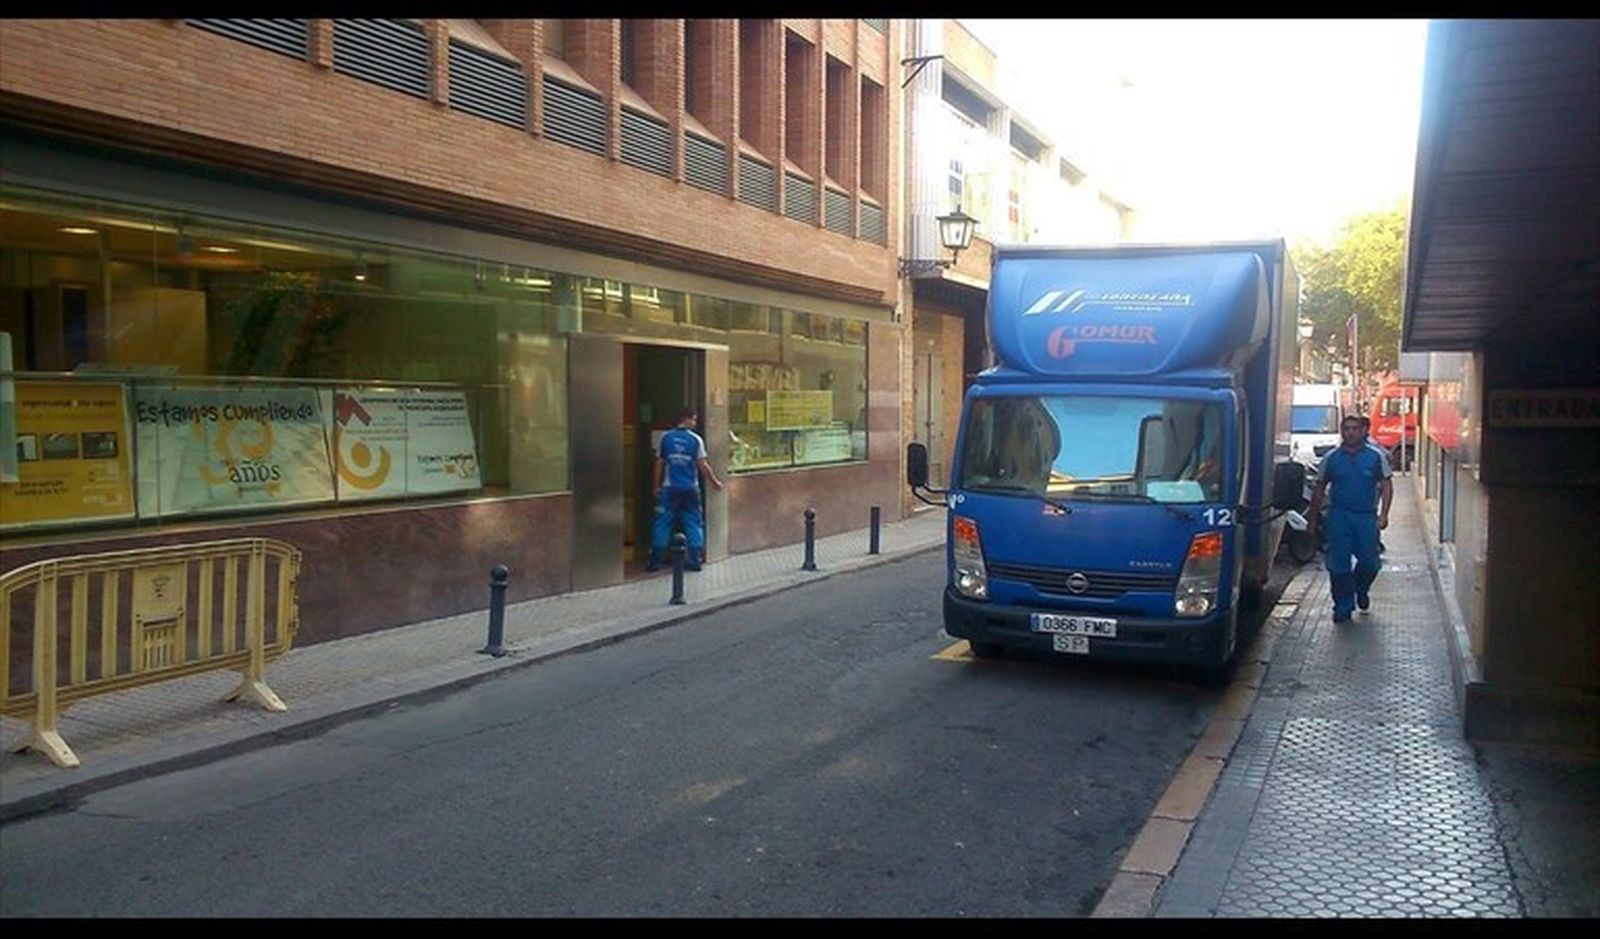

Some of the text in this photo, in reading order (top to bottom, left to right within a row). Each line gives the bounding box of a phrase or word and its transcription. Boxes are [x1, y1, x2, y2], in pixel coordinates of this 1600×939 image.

[1047, 324, 1158, 358] GOMUR
[136, 401, 220, 428] Estamos
[223, 400, 313, 426] cumpliendo
[228, 460, 281, 483] años
[1203, 508, 1237, 526] 12
[1043, 616, 1078, 632] 0366
